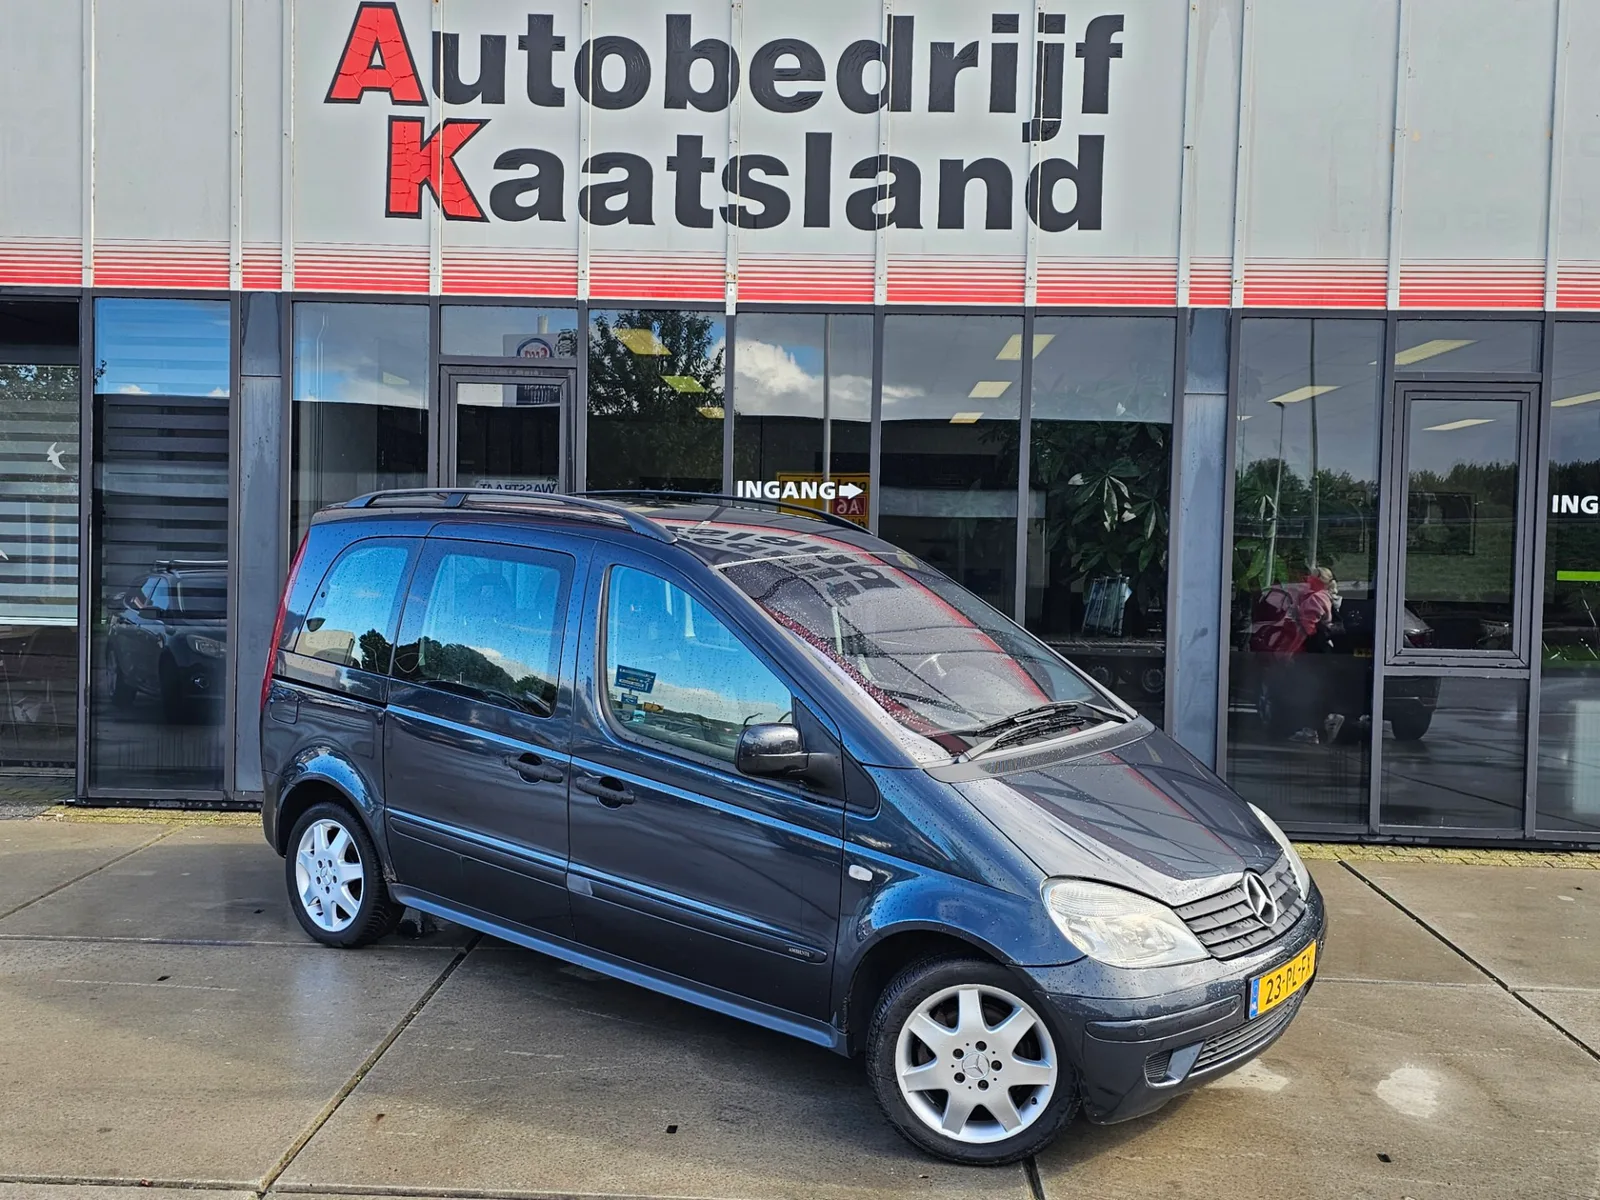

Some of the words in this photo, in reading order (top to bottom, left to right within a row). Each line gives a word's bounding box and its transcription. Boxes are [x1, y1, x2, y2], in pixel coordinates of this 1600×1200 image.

[324, 1, 1124, 143] Autobedrijf
[385, 115, 1105, 232] Kaatsland
[737, 480, 836, 499] INGANG
